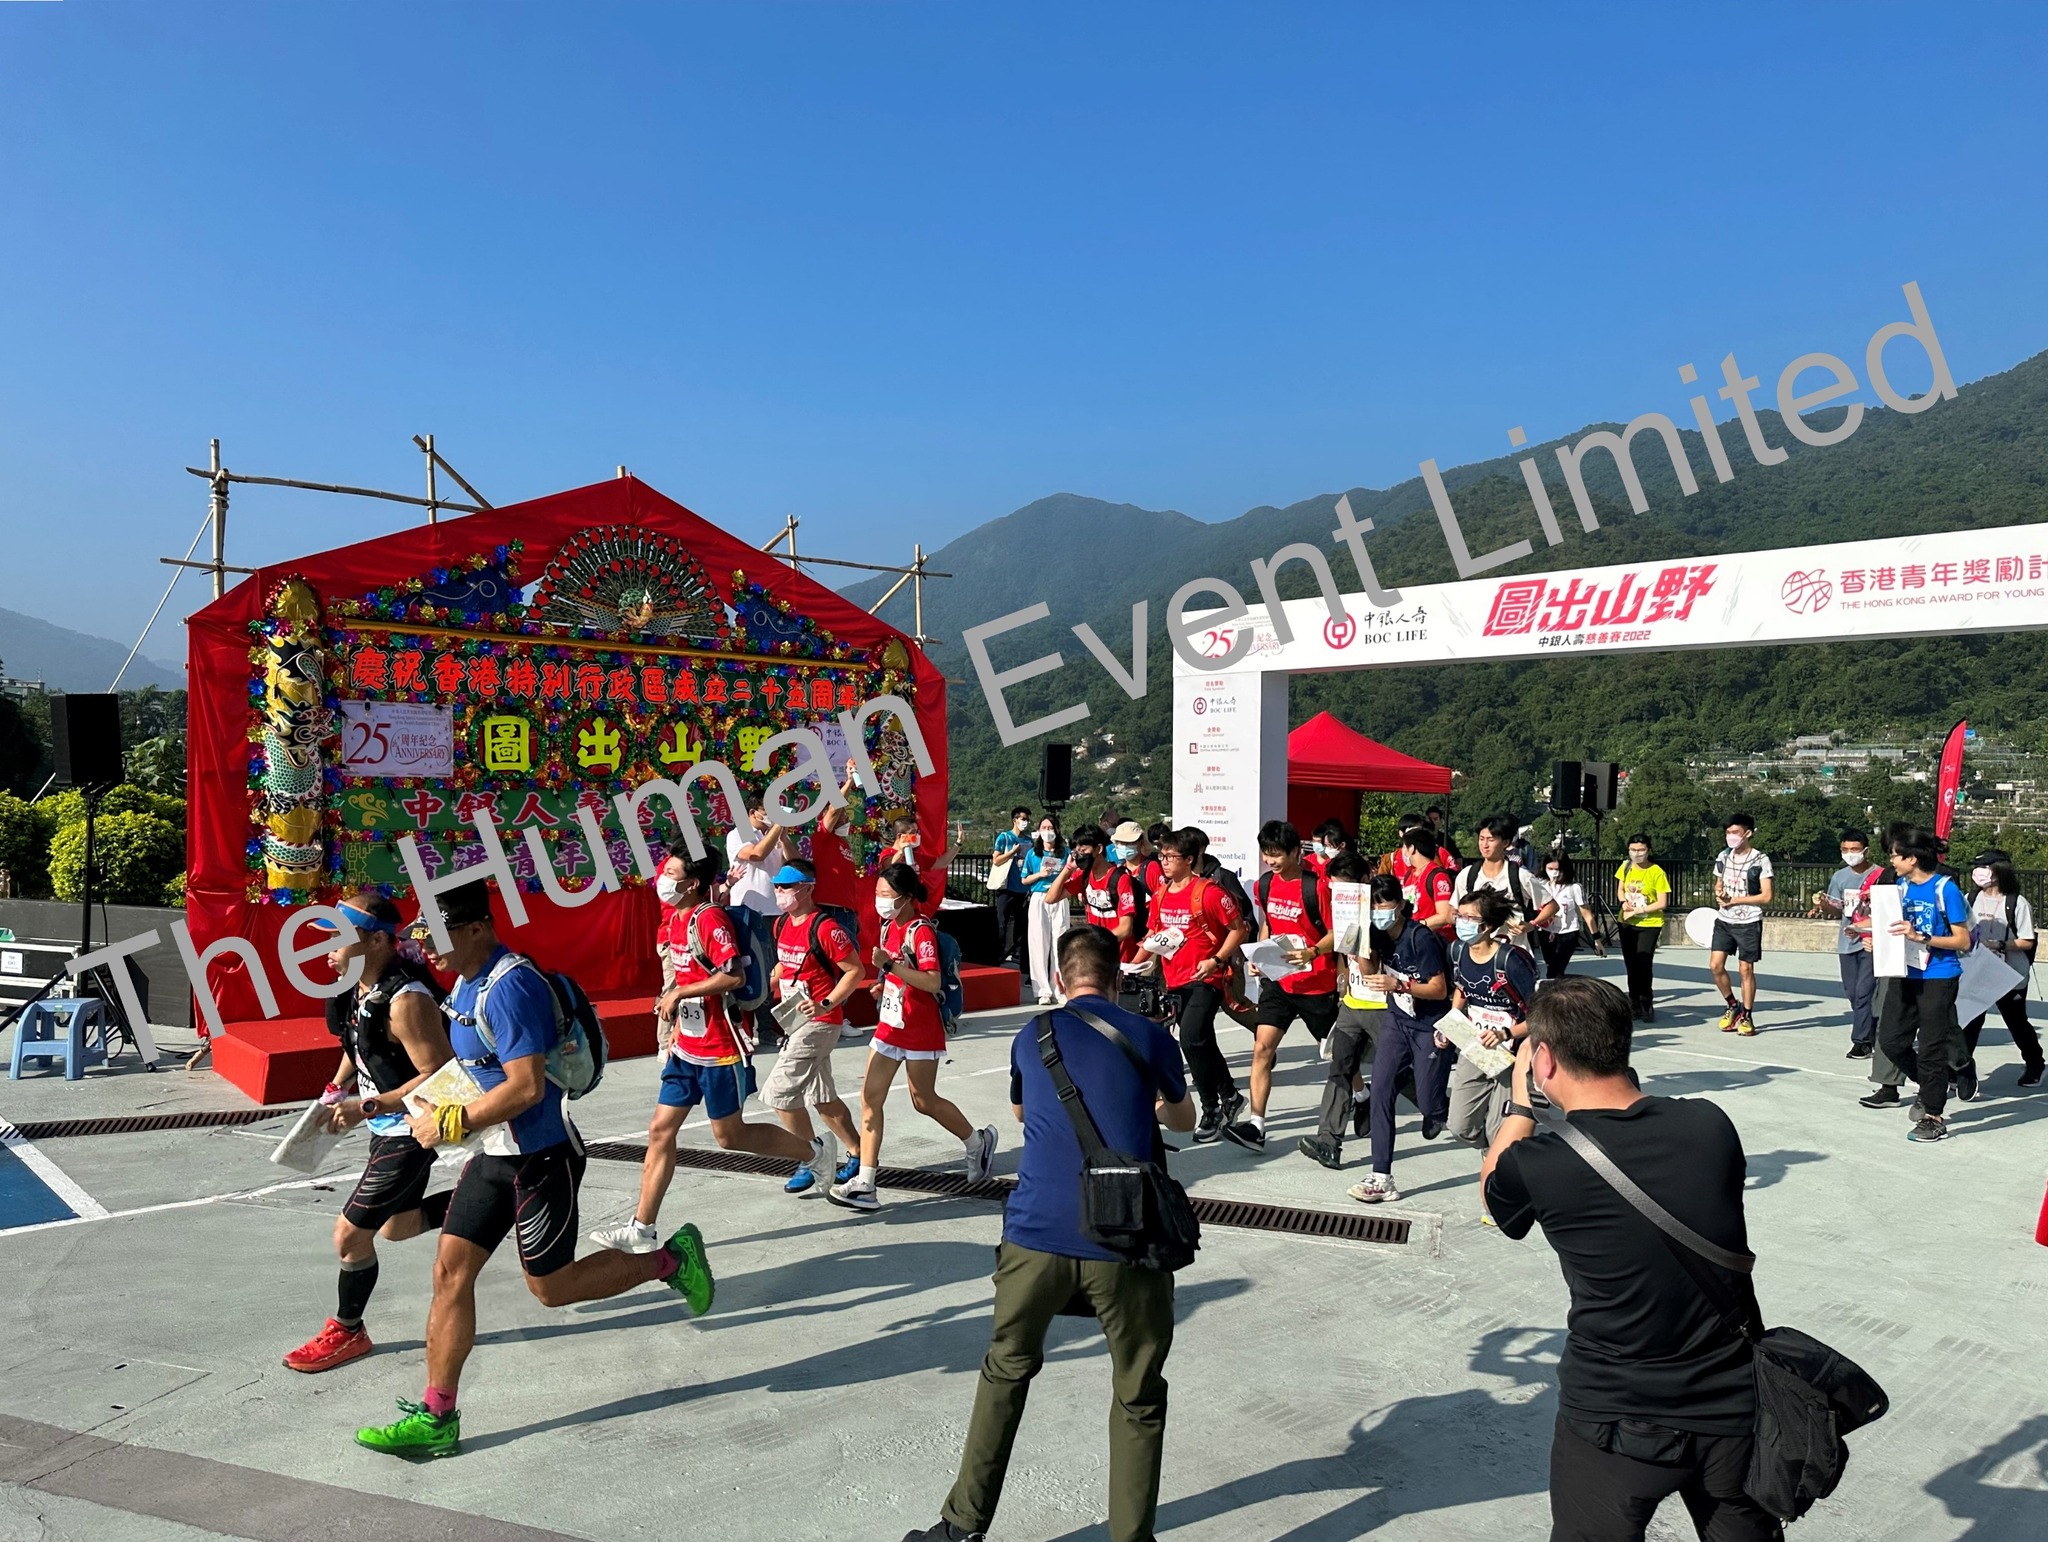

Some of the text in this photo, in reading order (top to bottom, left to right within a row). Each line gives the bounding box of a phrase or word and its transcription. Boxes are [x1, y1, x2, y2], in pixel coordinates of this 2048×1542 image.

[1482, 564, 1719, 637] 圖出山野
[1840, 588, 2045, 610] THE HONG KONG AWARD FOR YOUNG
[1365, 629, 1428, 645] BOC LIFE
[1622, 630, 1651, 642] 2022
[345, 722, 391, 765] 25
[401, 734, 437, 747] 周年紀念
[395, 746, 445, 759] ANNIVERSARY
